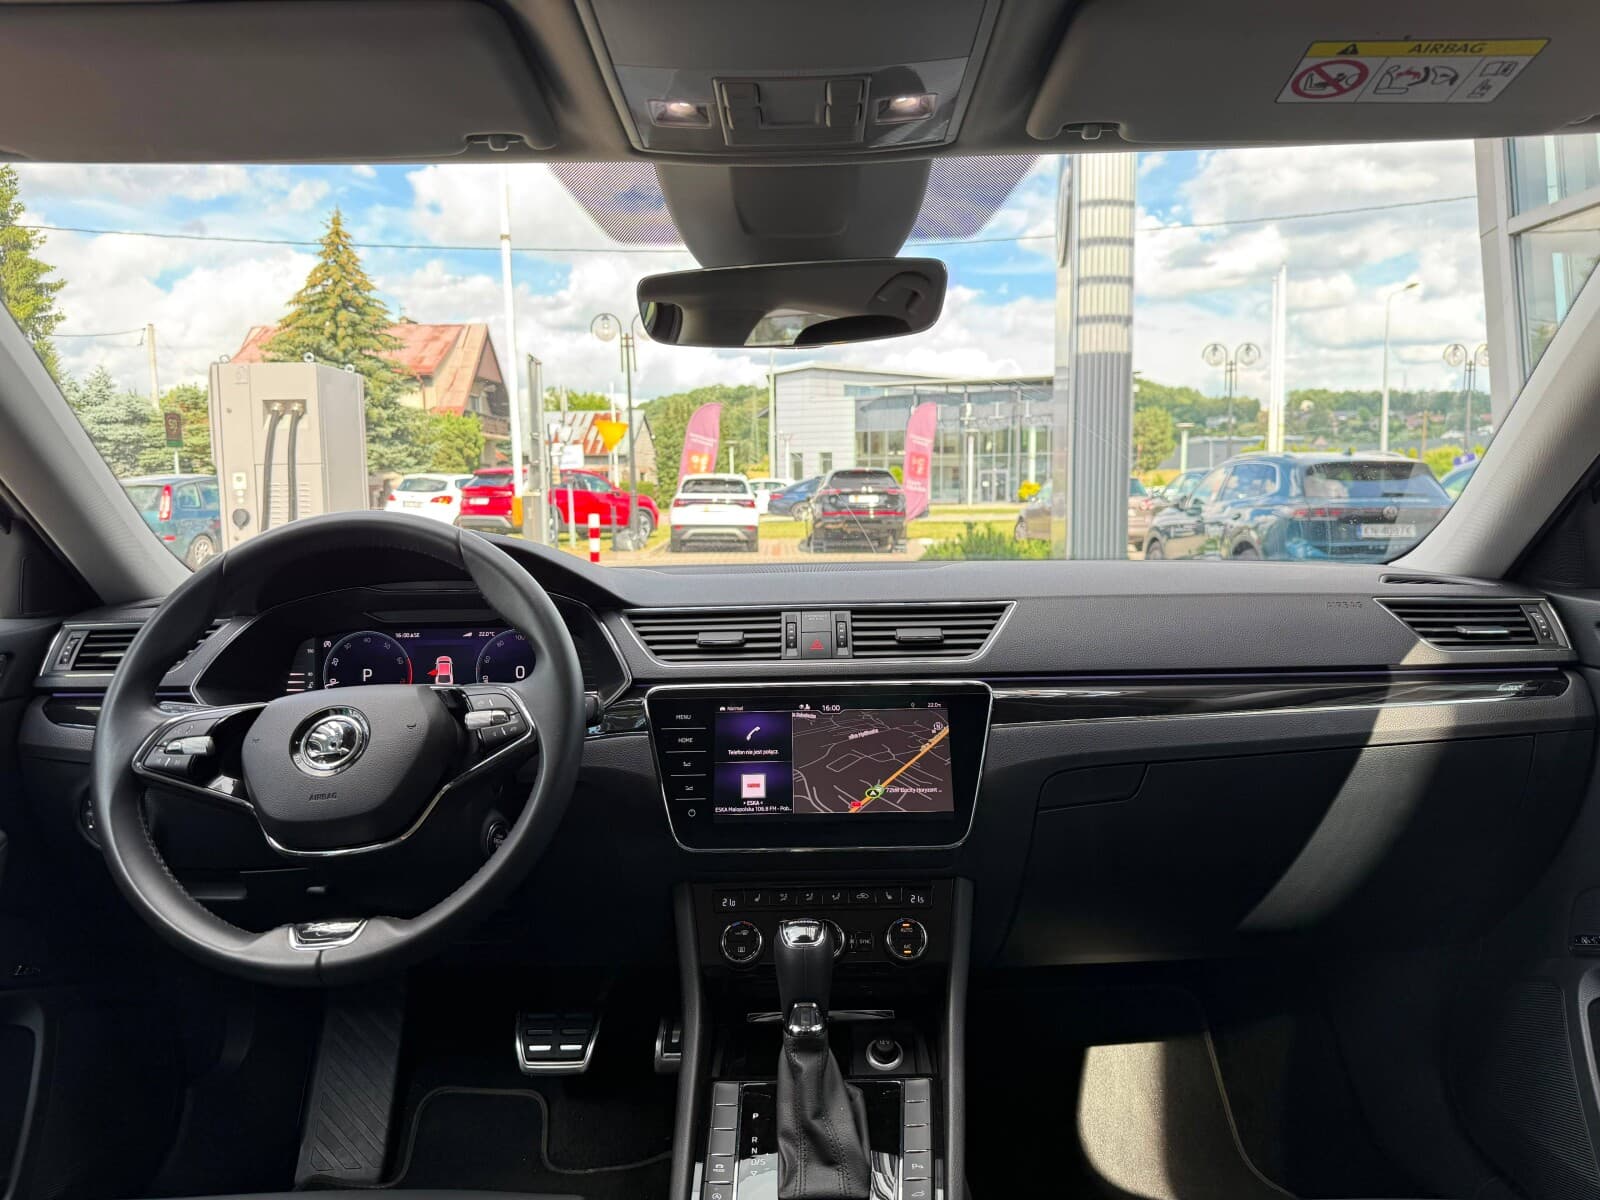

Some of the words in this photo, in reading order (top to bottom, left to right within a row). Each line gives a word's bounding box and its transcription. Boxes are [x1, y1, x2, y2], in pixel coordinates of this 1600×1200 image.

[1408, 43, 1488, 54] AIRBAG
[362, 668, 373, 682] P
[515, 665, 526, 679] 0
[309, 792, 337, 801] AIRBAG
[751, 1158, 766, 1166] D/S
